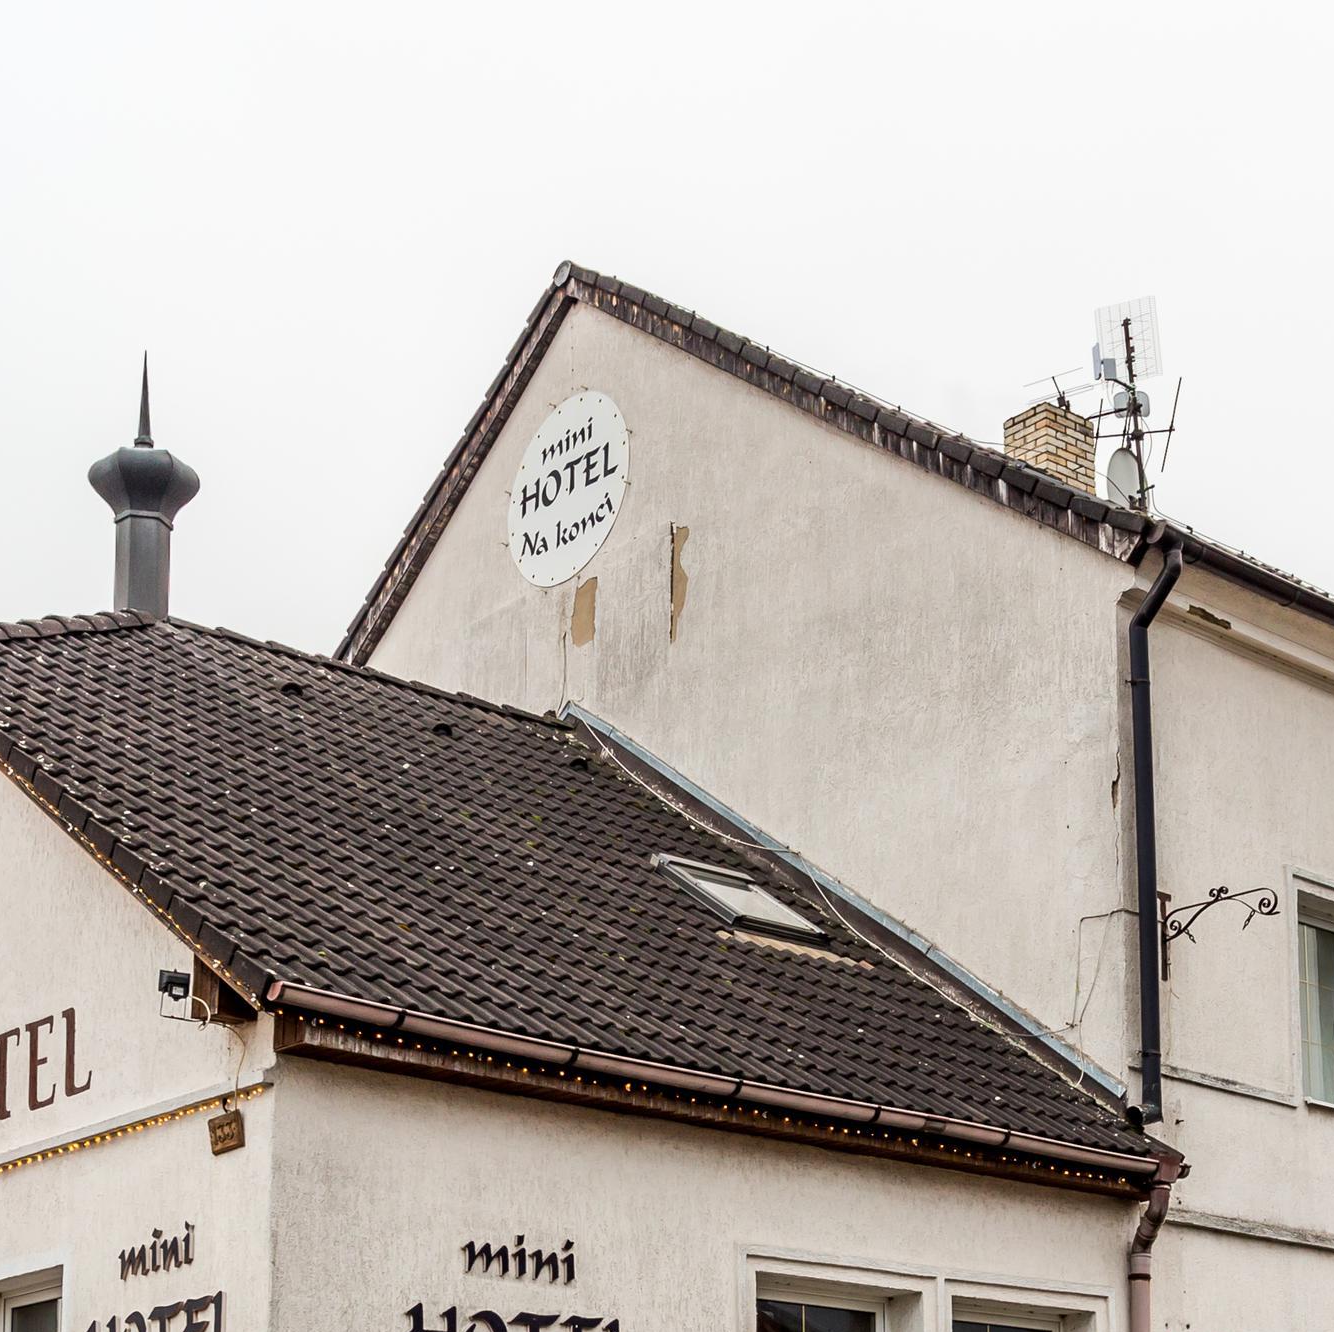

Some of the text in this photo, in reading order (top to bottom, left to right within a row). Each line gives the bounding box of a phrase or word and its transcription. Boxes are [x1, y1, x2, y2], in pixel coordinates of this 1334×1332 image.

[542, 417, 593, 465] mini
[520, 442, 618, 518] HOTEL
[521, 492, 613, 557] Na konci
[119, 1220, 195, 1281] mini
[461, 1234, 575, 1285] mini
